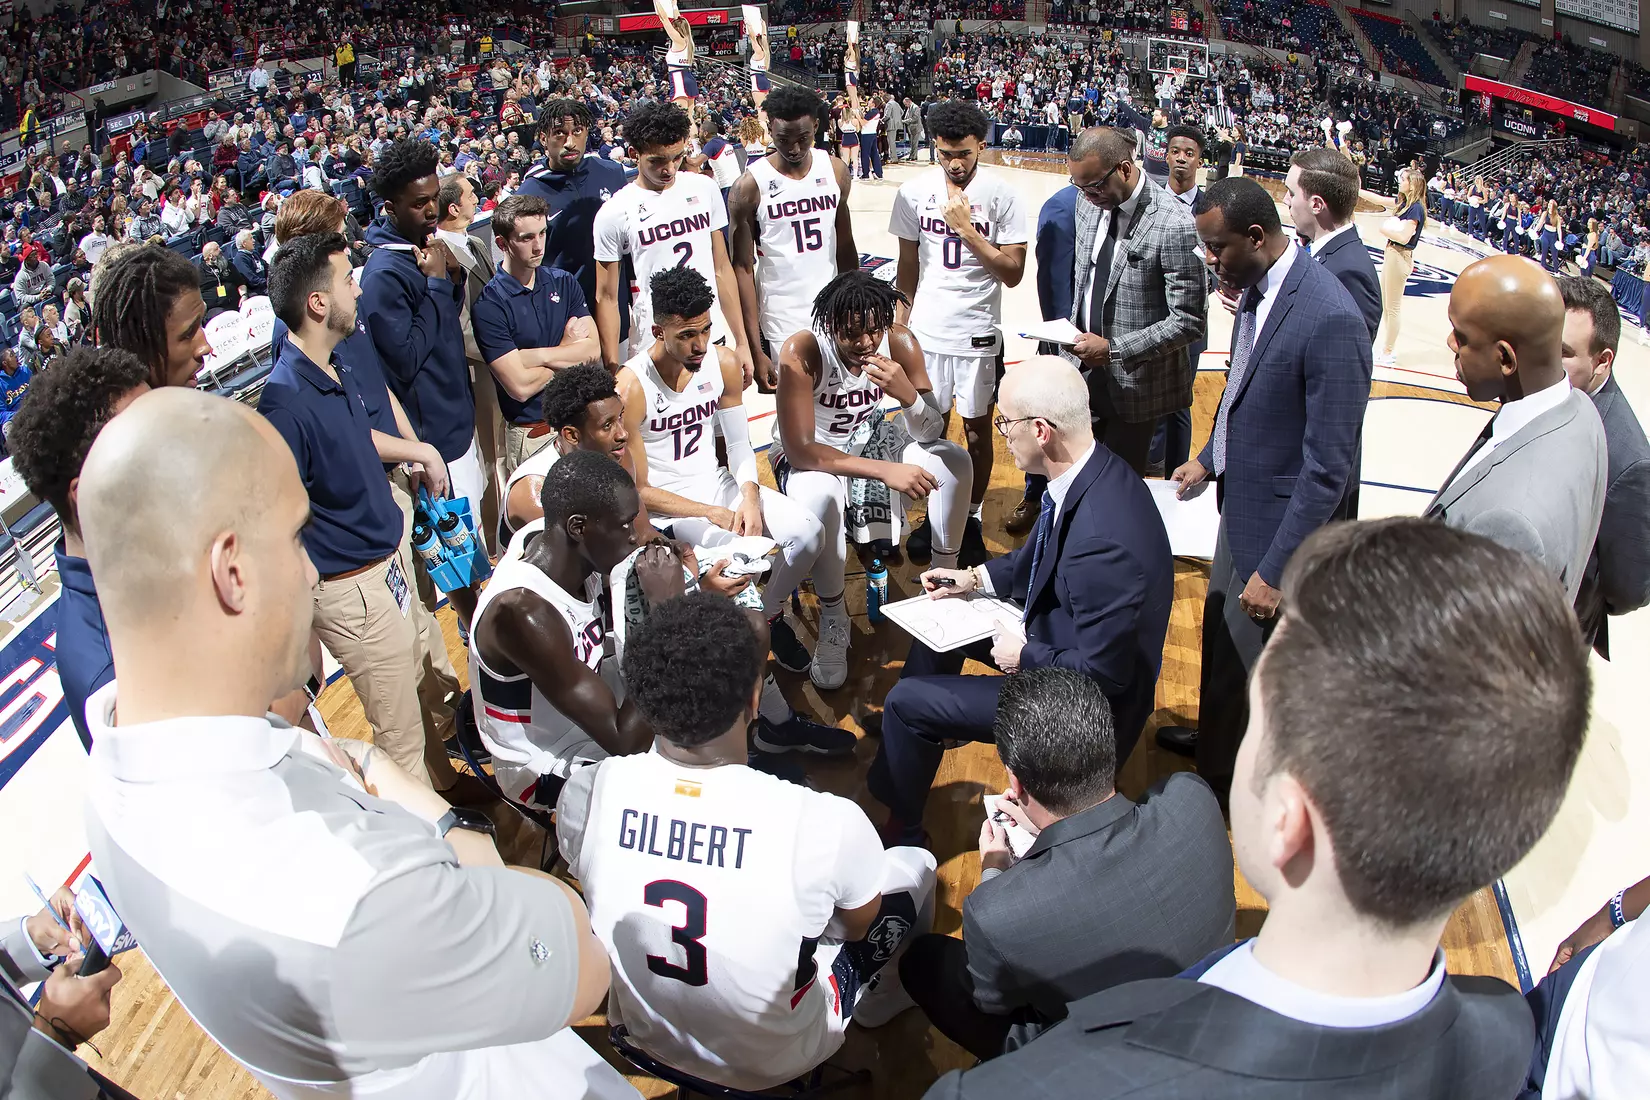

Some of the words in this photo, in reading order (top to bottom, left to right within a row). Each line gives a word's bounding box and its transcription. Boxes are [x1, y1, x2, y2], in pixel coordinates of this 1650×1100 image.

[711, 41, 735, 50] Coke
[110, 120, 123, 129] SEC
[128, 111, 146, 126] 121
[1504, 119, 1536, 135] UCONN
[767, 194, 837, 220] UCONN
[638, 212, 710, 246] UCONN
[791, 217, 823, 253] 15
[673, 241, 695, 271] 2
[943, 237, 962, 270] 0
[671, 423, 703, 461] 12
[619, 808, 753, 869] GILBERT
[644, 879, 708, 986] 3
